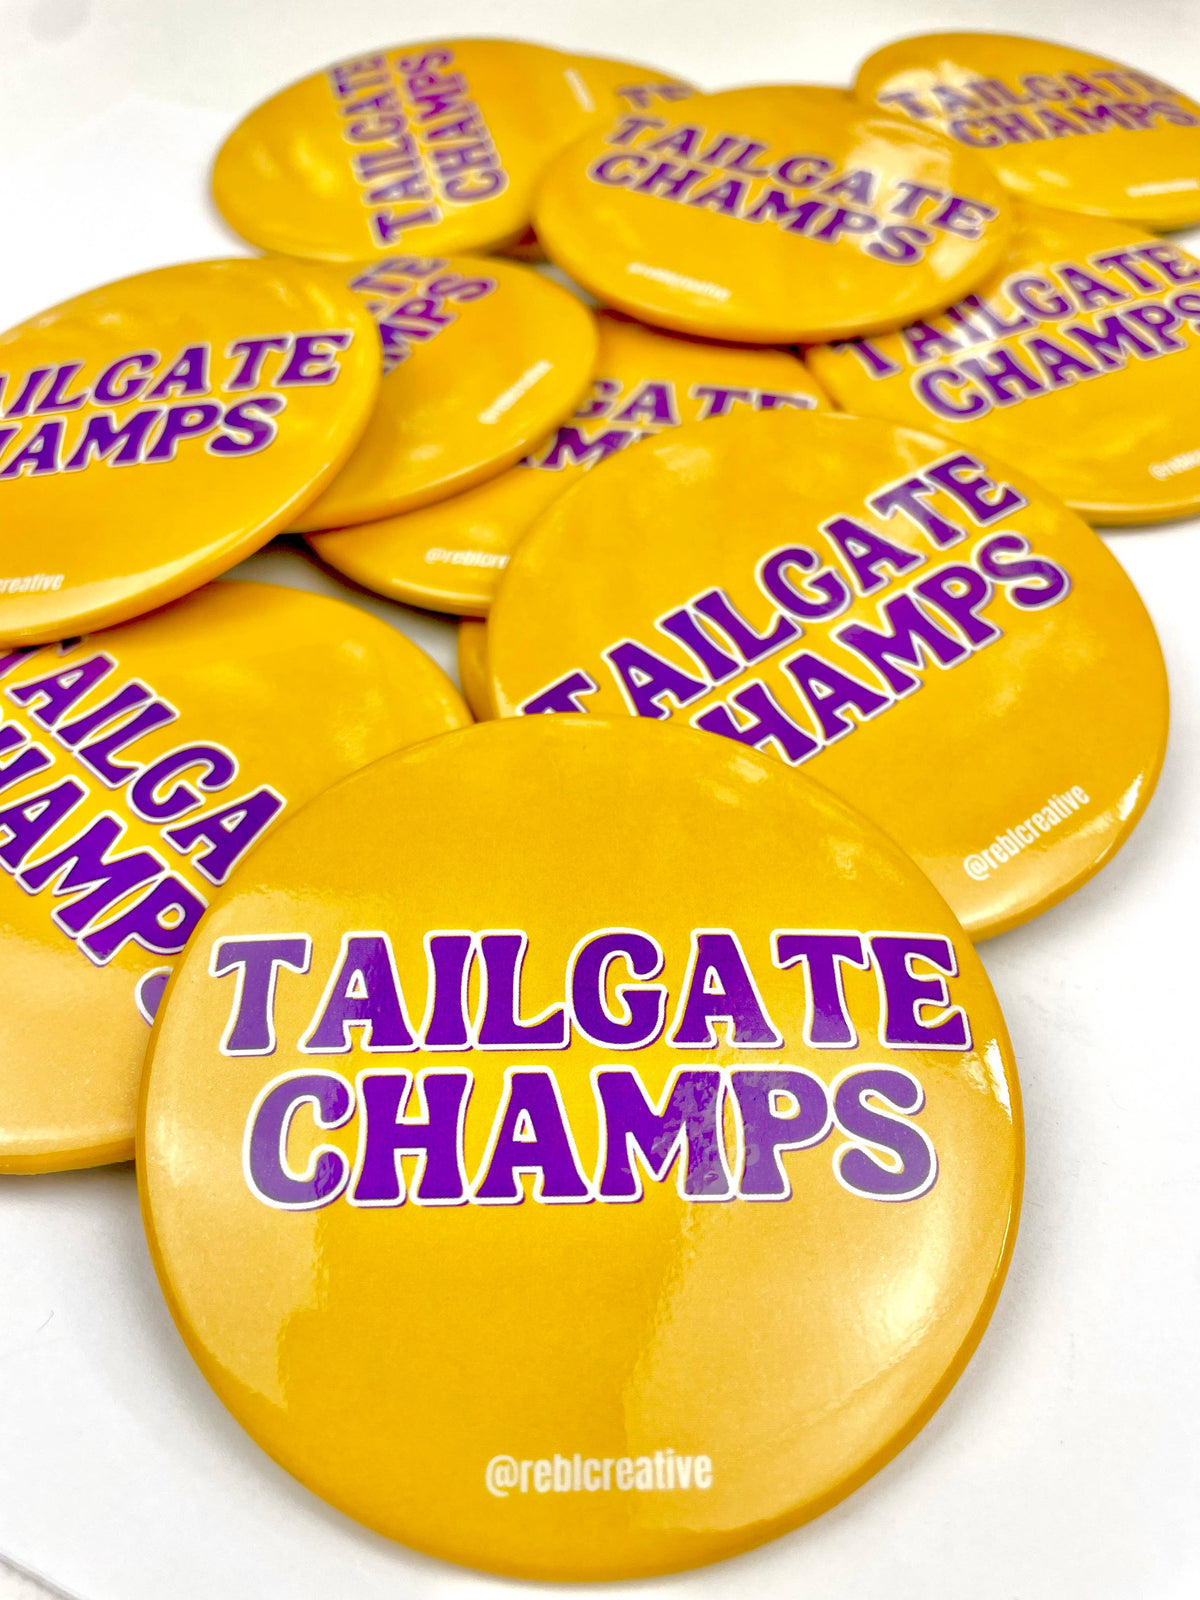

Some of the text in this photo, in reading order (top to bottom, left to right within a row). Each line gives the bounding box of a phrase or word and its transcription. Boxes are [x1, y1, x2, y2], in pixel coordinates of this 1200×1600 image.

[397, 47, 509, 206] CHAMPS
[601, 114, 1000, 242] TAILGATE
[586, 152, 936, 266] CHAMPS
[0, 329, 354, 421] ILGATE
[689, 532, 1072, 766] HAMPS
[963, 784, 1091, 881] @reblcreative
[209, 928, 973, 1057] TAILGATE
[242, 1063, 940, 1212] CHAMPS
[485, 1448, 713, 1498] @reblcreative
